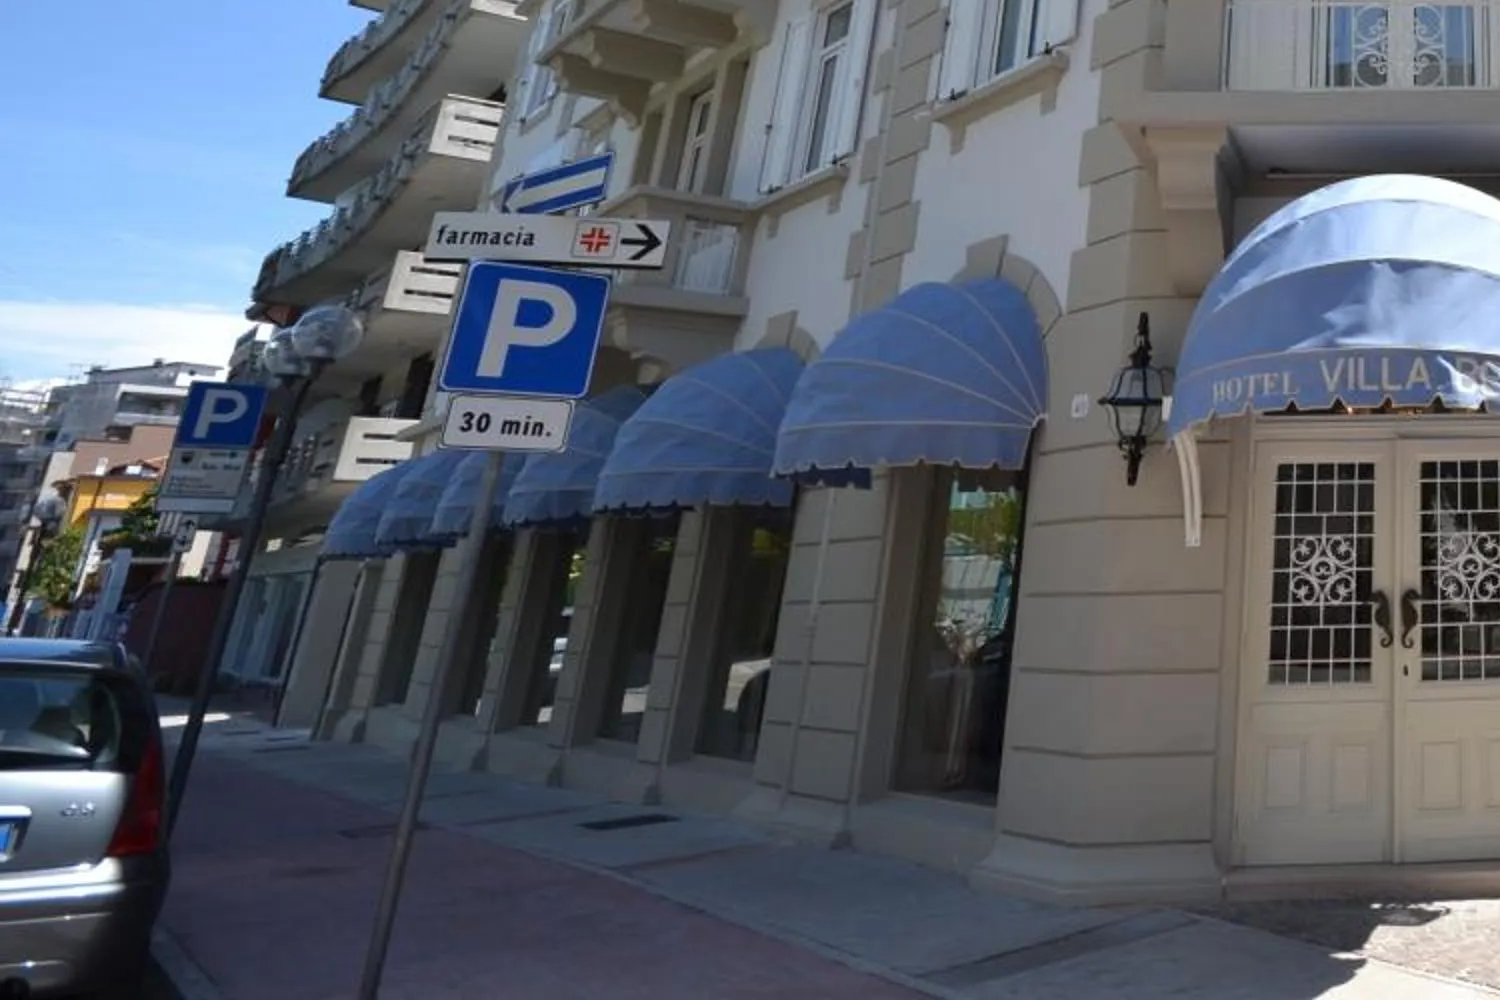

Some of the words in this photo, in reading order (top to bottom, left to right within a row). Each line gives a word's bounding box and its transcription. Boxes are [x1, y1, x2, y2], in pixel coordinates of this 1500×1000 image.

[436, 225, 536, 247] farmacia
[475, 278, 578, 378] P
[1212, 370, 1300, 403] HOTEL
[1319, 355, 1432, 393] VILLA
[192, 388, 250, 440] P
[459, 411, 491, 434] 30
[499, 415, 553, 438] min.
